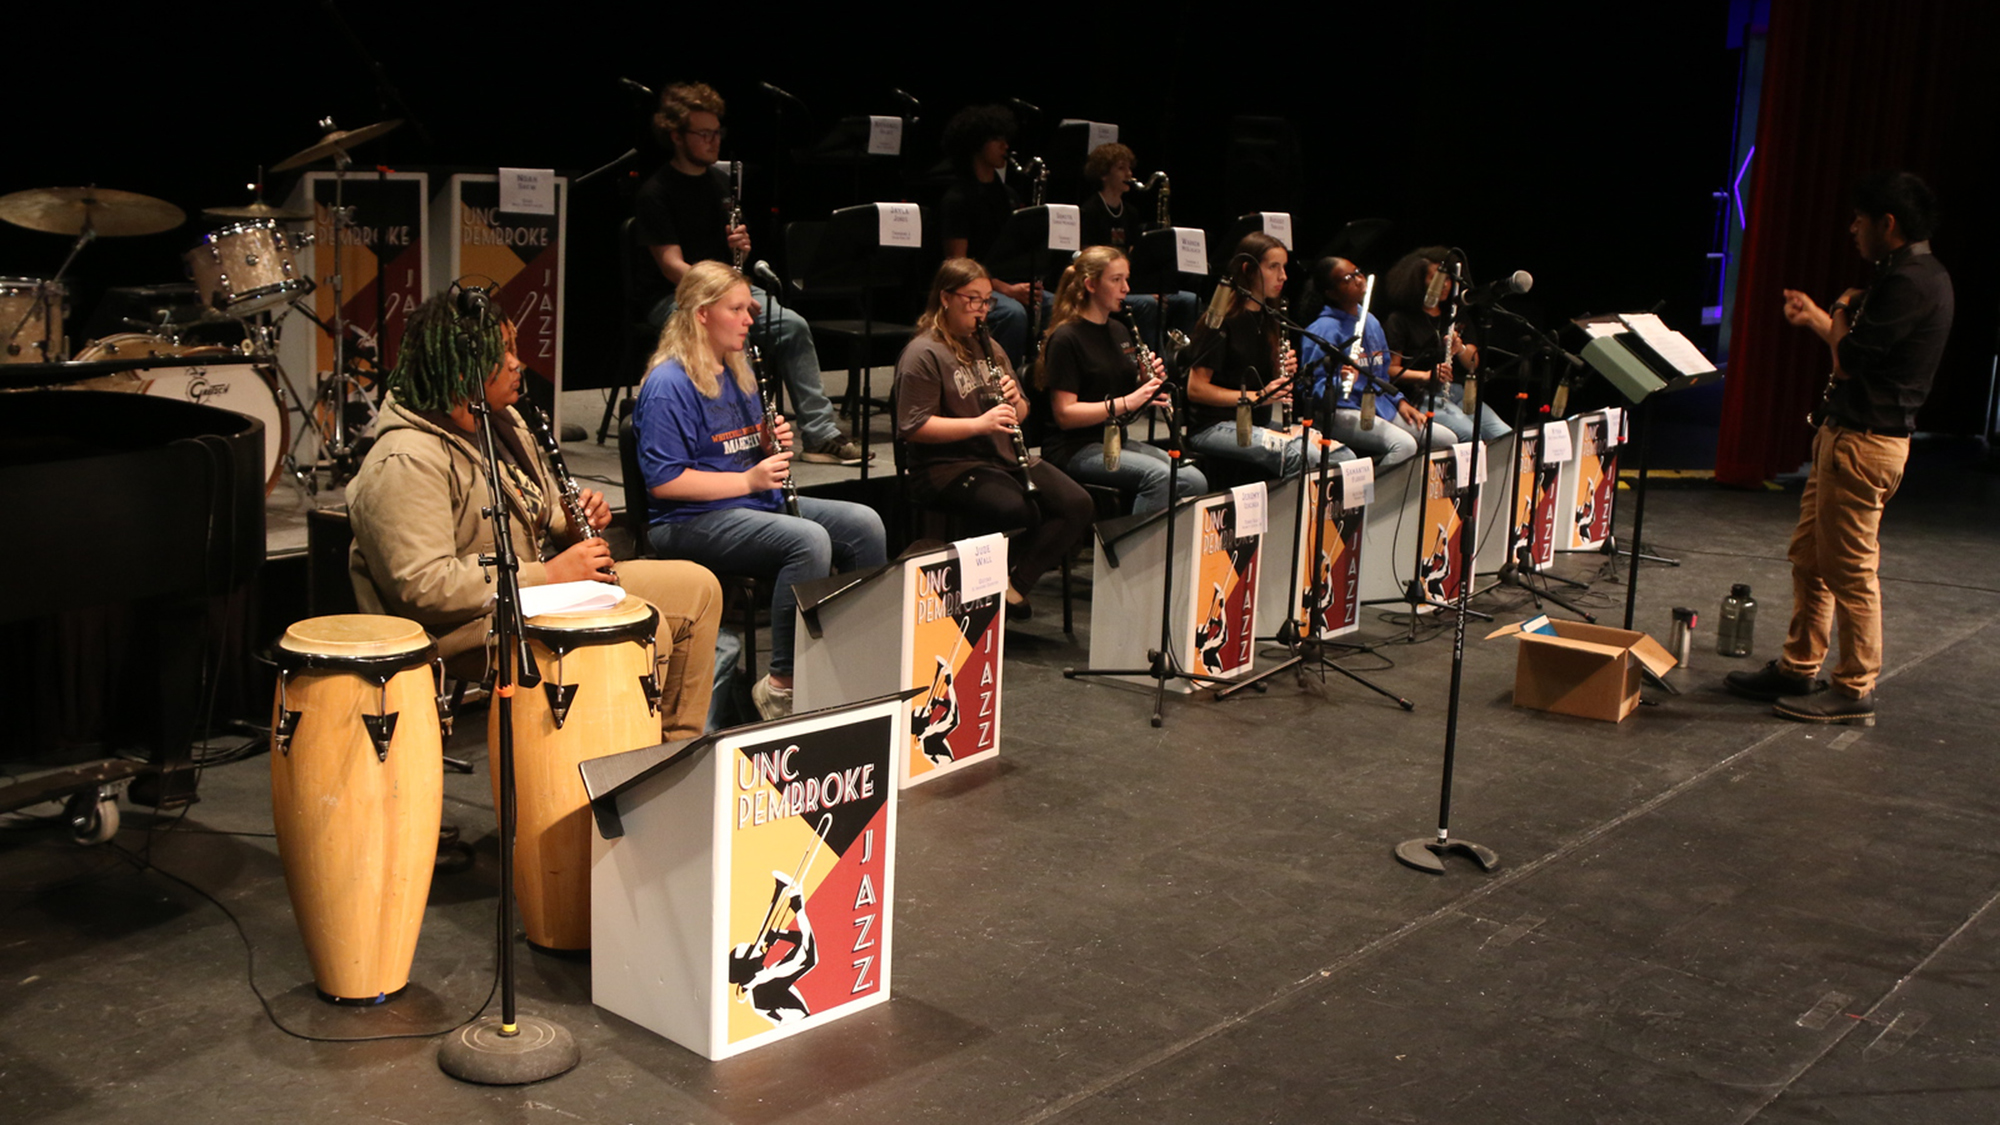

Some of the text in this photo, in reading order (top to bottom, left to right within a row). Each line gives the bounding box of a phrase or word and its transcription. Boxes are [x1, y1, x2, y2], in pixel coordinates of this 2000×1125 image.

[463, 226, 549, 247] PEMBROKE
[464, 206, 501, 226] UNC
[538, 268, 554, 359] JAZZ
[1204, 508, 1229, 533] UNC
[1541, 482, 1555, 561] JAZZ
[1600, 465, 1613, 538] JAZZ
[918, 565, 953, 597] UNC
[1239, 561, 1254, 663] JAZZ
[1345, 531, 1358, 623] JAZZ
[976, 628, 995, 748] JAZZ
[737, 763, 875, 831] PEMBROKE
[738, 744, 800, 790] UNC
[851, 828, 877, 995] JAZZ
